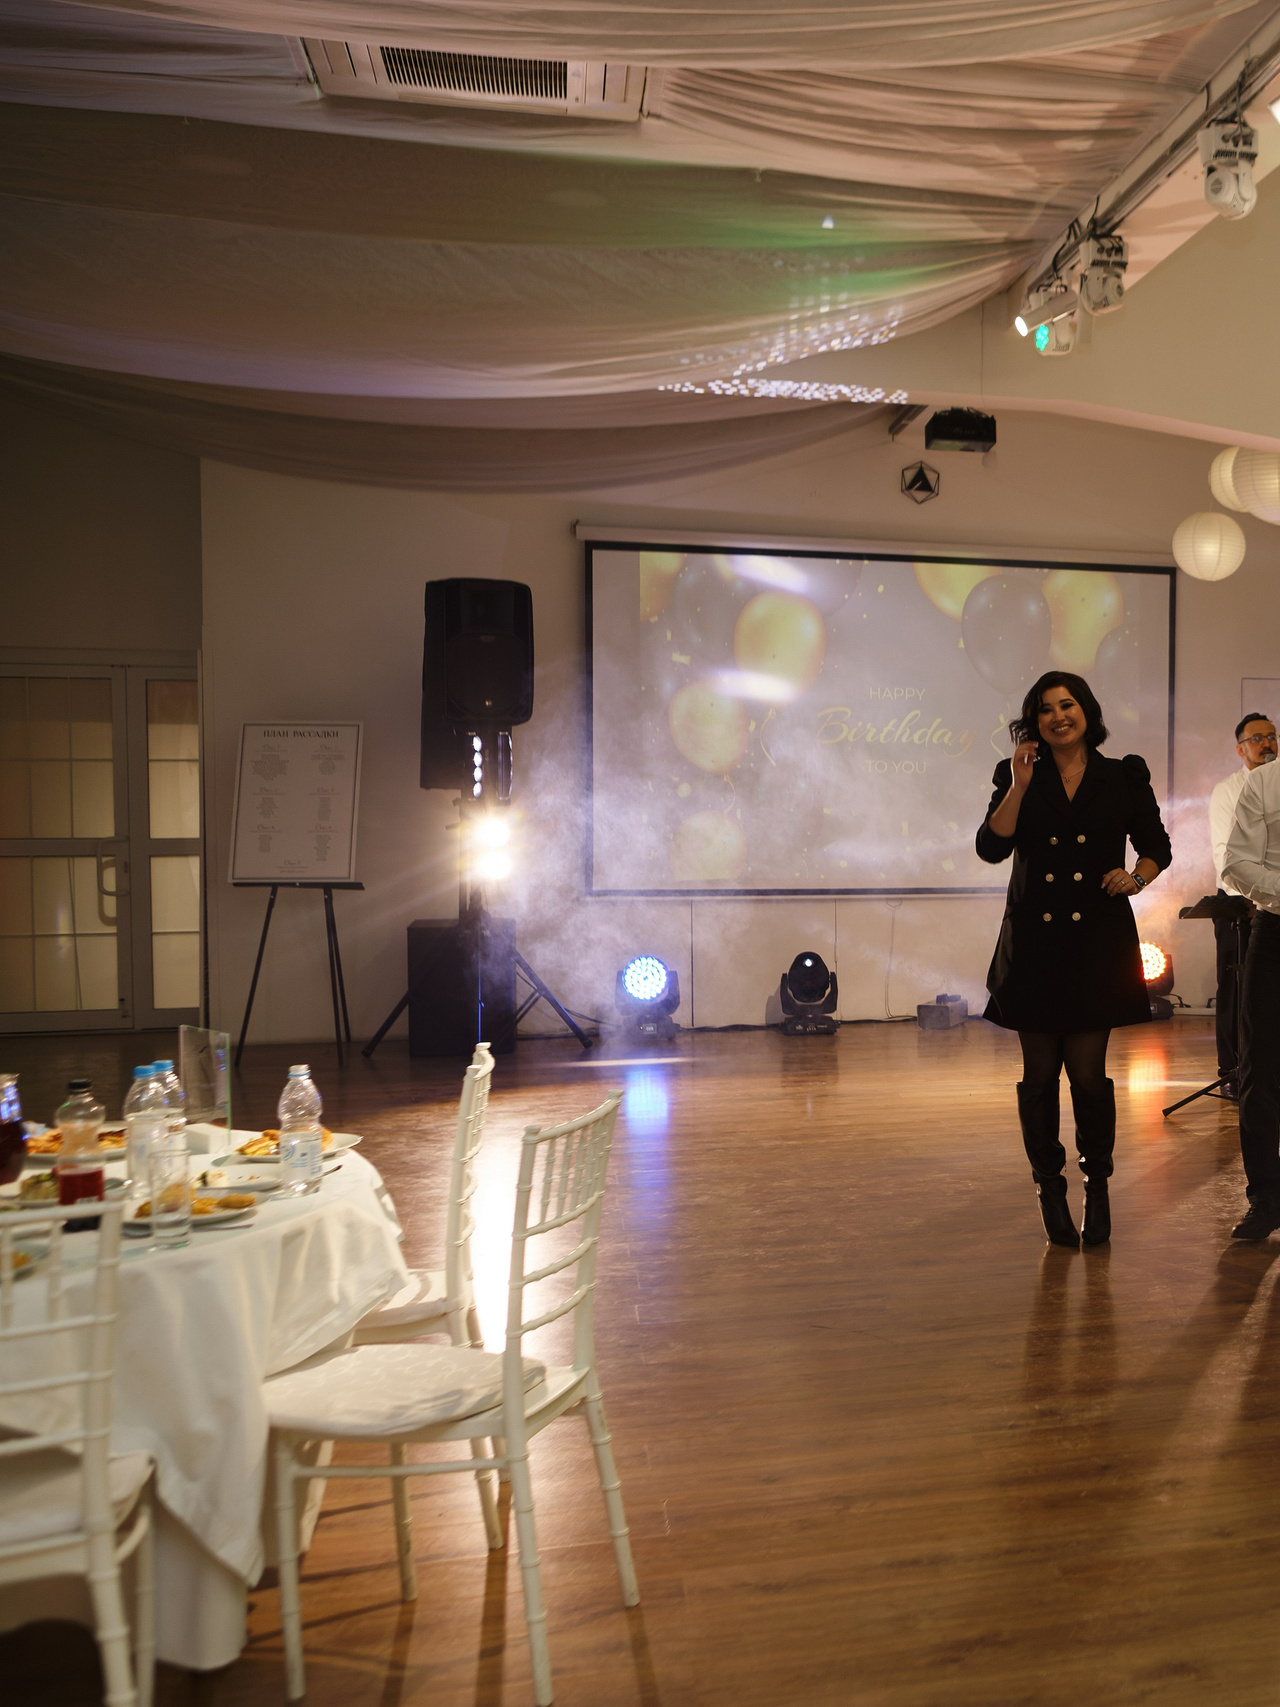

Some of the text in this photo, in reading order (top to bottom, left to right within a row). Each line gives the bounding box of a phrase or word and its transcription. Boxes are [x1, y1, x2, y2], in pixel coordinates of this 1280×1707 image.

[869, 687, 926, 700] HAPPY
[263, 729, 339, 738] ПЛАН РАССАДКИ
[816, 706, 977, 758] Birthday
[866, 760, 927, 774] TO YOU
